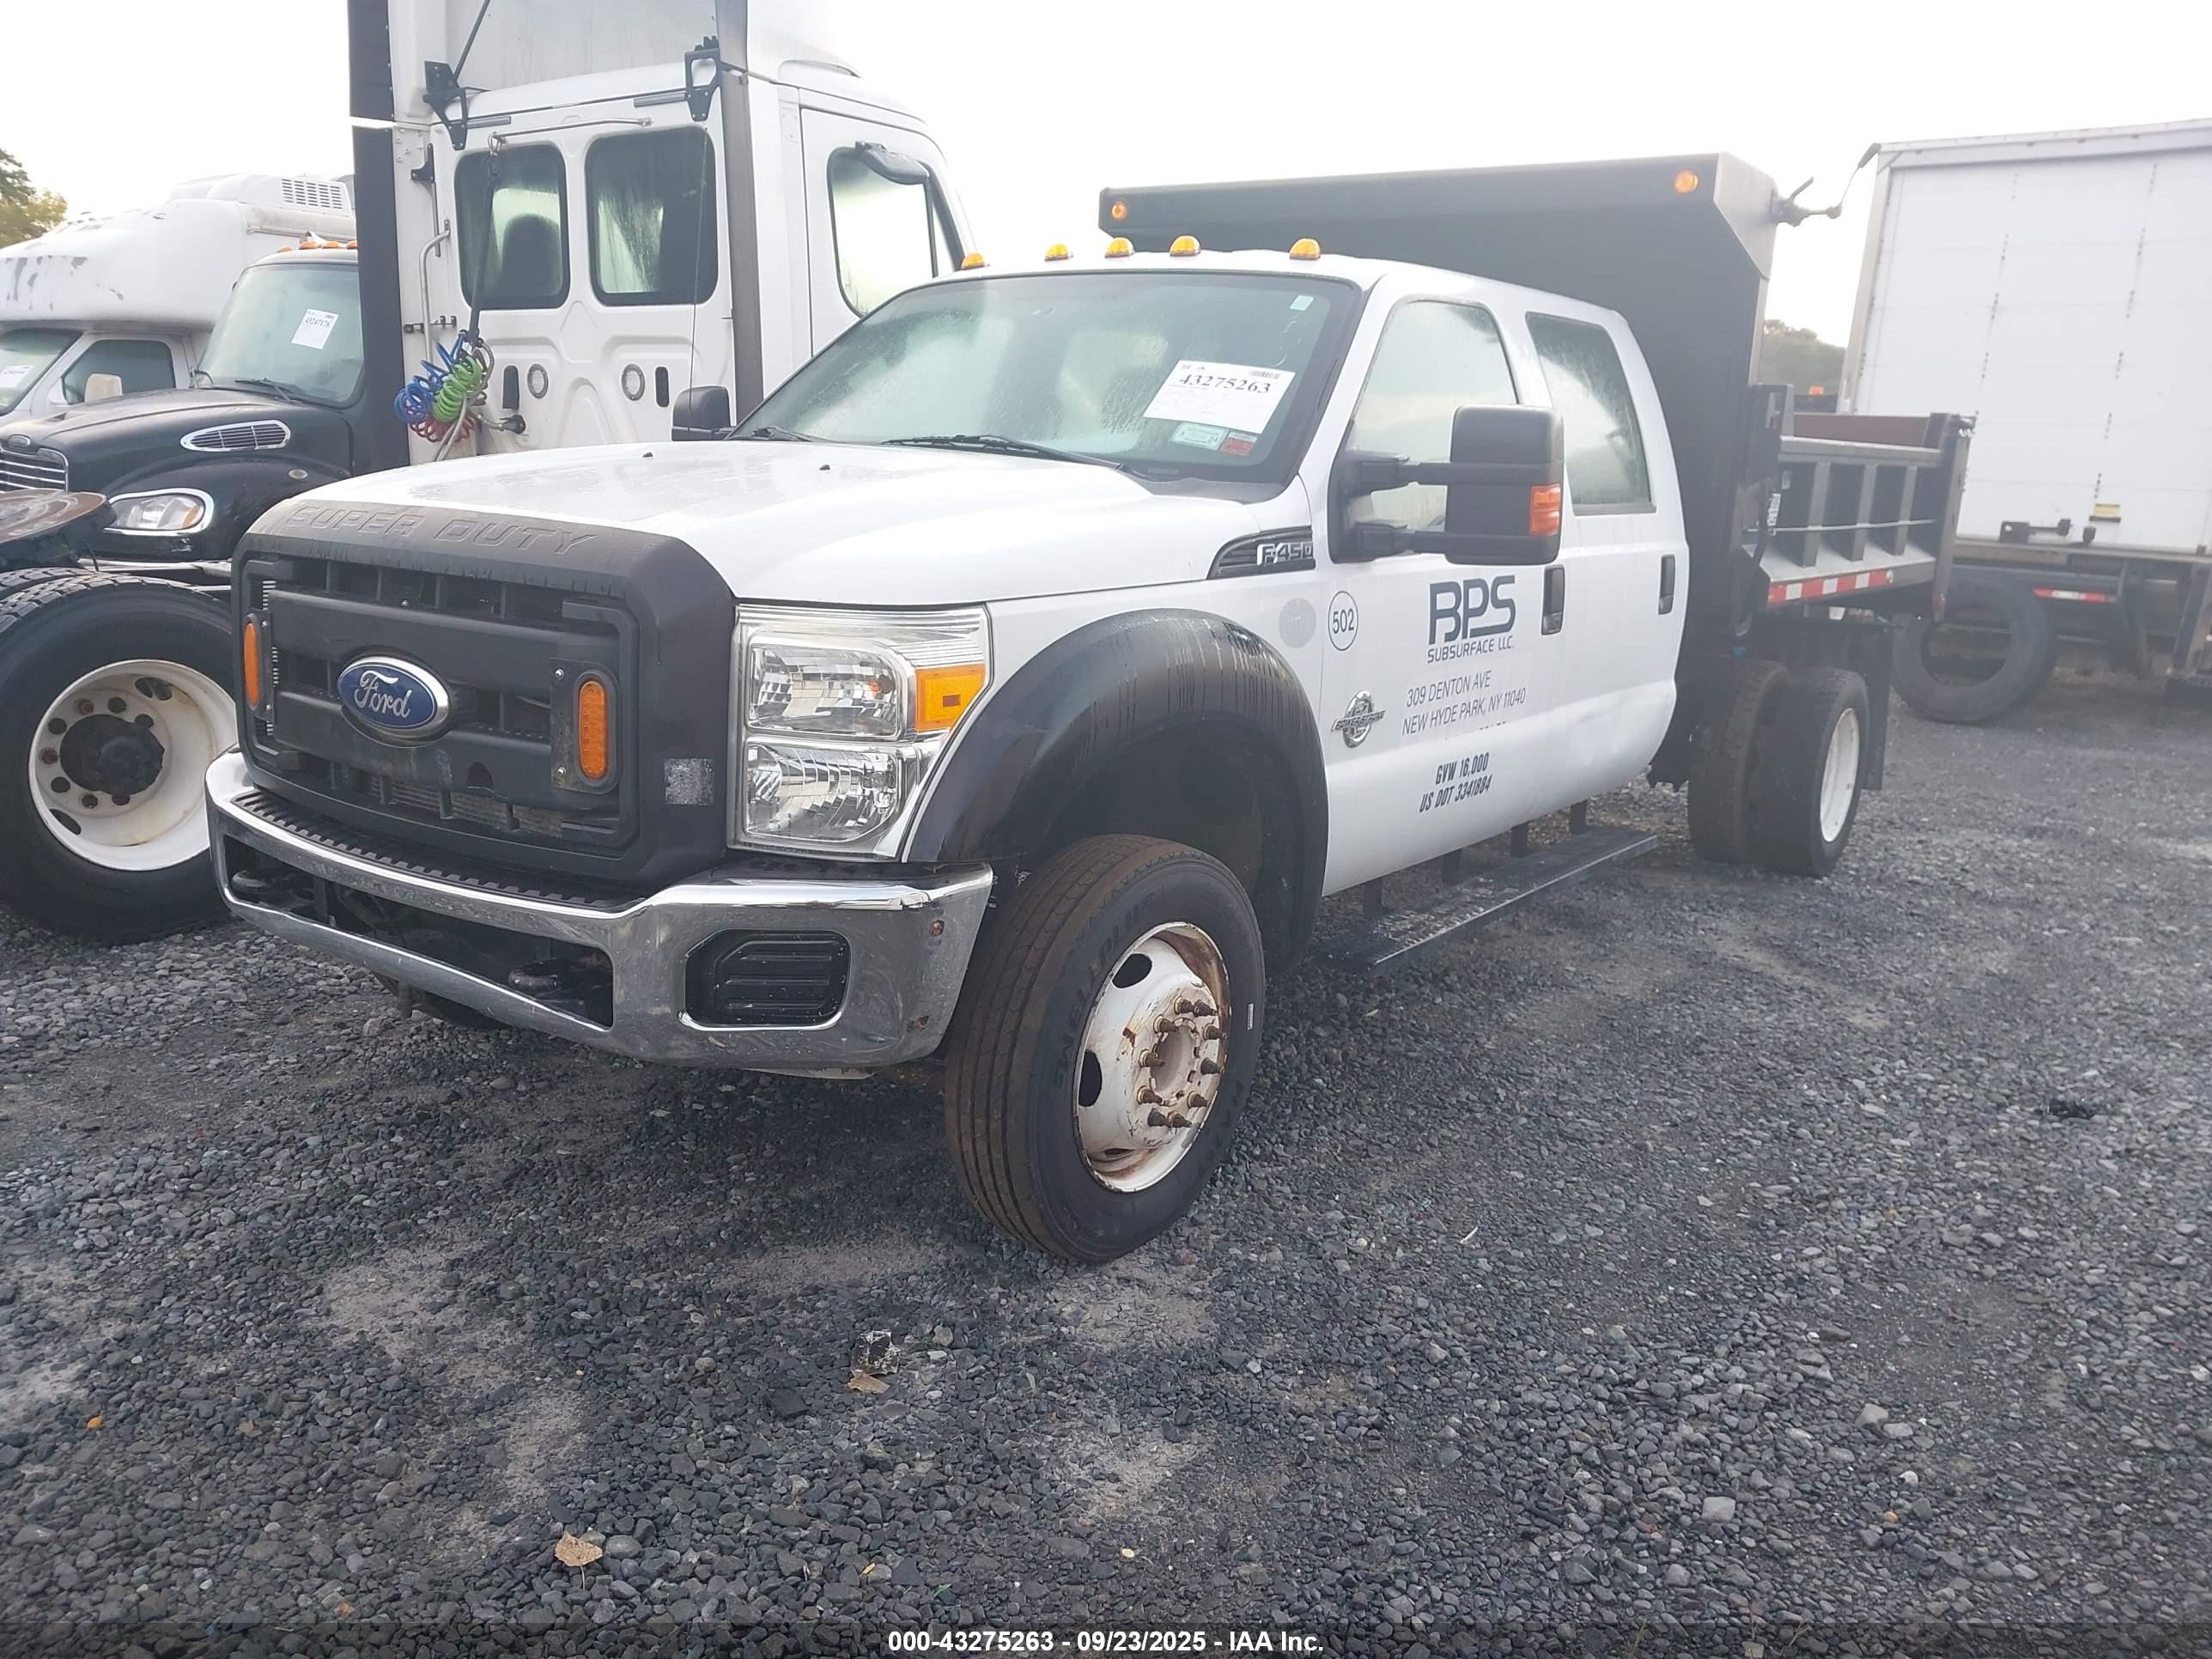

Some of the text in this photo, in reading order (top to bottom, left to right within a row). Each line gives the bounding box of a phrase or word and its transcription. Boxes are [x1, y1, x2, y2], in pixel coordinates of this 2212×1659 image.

[1179, 374, 1271, 394] 43275263
[287, 503, 599, 555] SUPER DUTY
[1332, 607, 1355, 635] 502
[1428, 574, 1516, 646] BPS
[1427, 638, 1495, 664] SUBSURFACE
[354, 670, 413, 718] Ford
[1406, 670, 1492, 708] 309 DENTON AVE
[1402, 712, 1428, 736] NEW
[1429, 704, 1458, 728] HYDE
[1487, 691, 1503, 712] NY
[1503, 687, 1526, 709] 11040
[1435, 751, 1490, 785] GVW 16,000
[1419, 774, 1492, 813] US DOT 3341884
